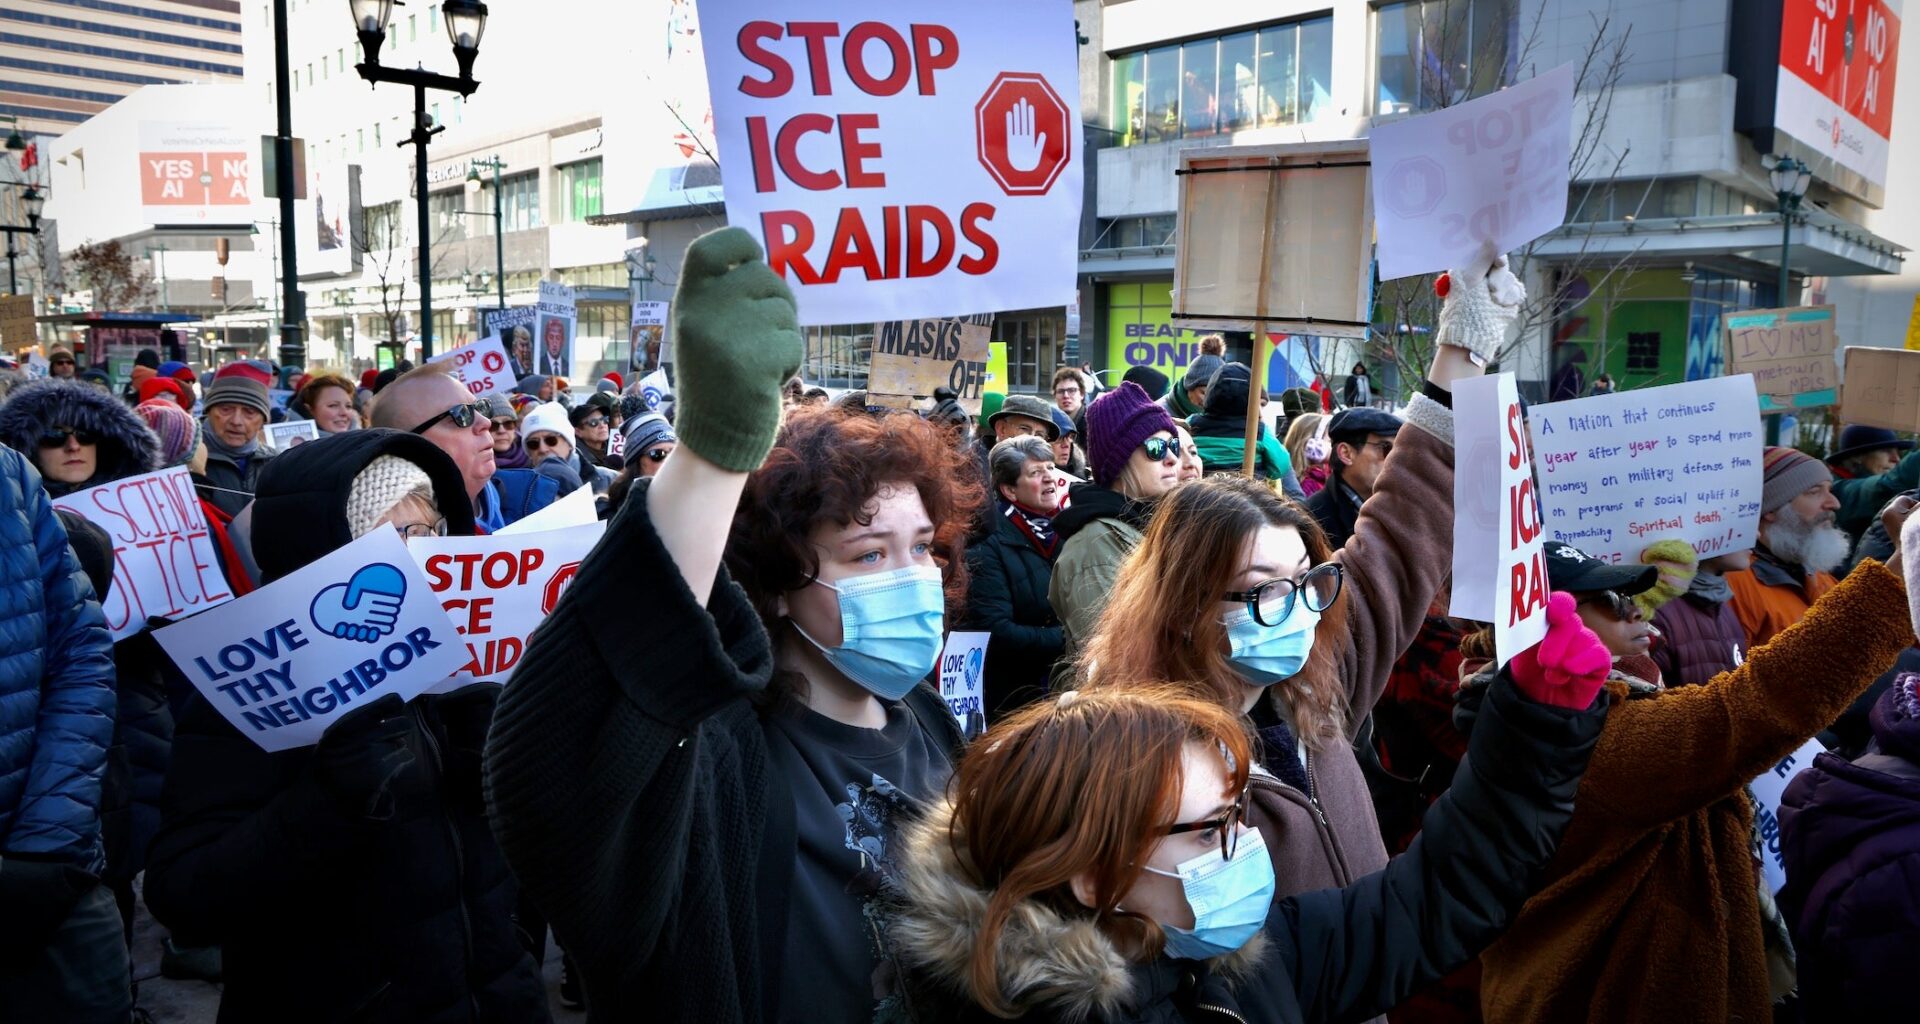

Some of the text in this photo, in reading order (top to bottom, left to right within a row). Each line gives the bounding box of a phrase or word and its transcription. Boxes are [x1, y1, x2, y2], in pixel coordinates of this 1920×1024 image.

[1806, 16, 1827, 75] AI
[1864, 5, 1886, 63] NO
[737, 20, 960, 98] STOP
[1862, 65, 1880, 115] AI
[149, 159, 194, 178] YES
[746, 113, 886, 193] ICE
[161, 179, 184, 198] AI
[760, 202, 1000, 285] RAIDS
[879, 320, 961, 361] MASKS
[1125, 341, 1200, 367] ON
[1790, 325, 1823, 354] MY
[950, 359, 987, 400] OFF
[1568, 414, 1613, 432] nation
[1623, 408, 1649, 425] that
[1657, 402, 1716, 420] continues
[1544, 430, 1753, 473] year after year to spend more
[1549, 481, 1588, 495] money
[1601, 475, 1619, 487] on
[1628, 467, 1674, 483] military
[1683, 461, 1724, 475] defense
[92, 471, 208, 543] SCIENCE
[1552, 507, 1566, 518] on
[1578, 502, 1624, 520] programs
[1634, 497, 1645, 509] of
[1654, 491, 1687, 506] social
[1730, 488, 1740, 498] is
[1554, 527, 1613, 543] approaching
[1628, 515, 1683, 539] Spiritual
[425, 548, 545, 593] STOP
[193, 618, 310, 682] LOVE
[448, 634, 535, 678] AID
[943, 654, 965, 674] LOVE
[217, 660, 299, 708] THY
[240, 625, 443, 732] NEIGHBOR
[942, 676, 957, 697] THY
